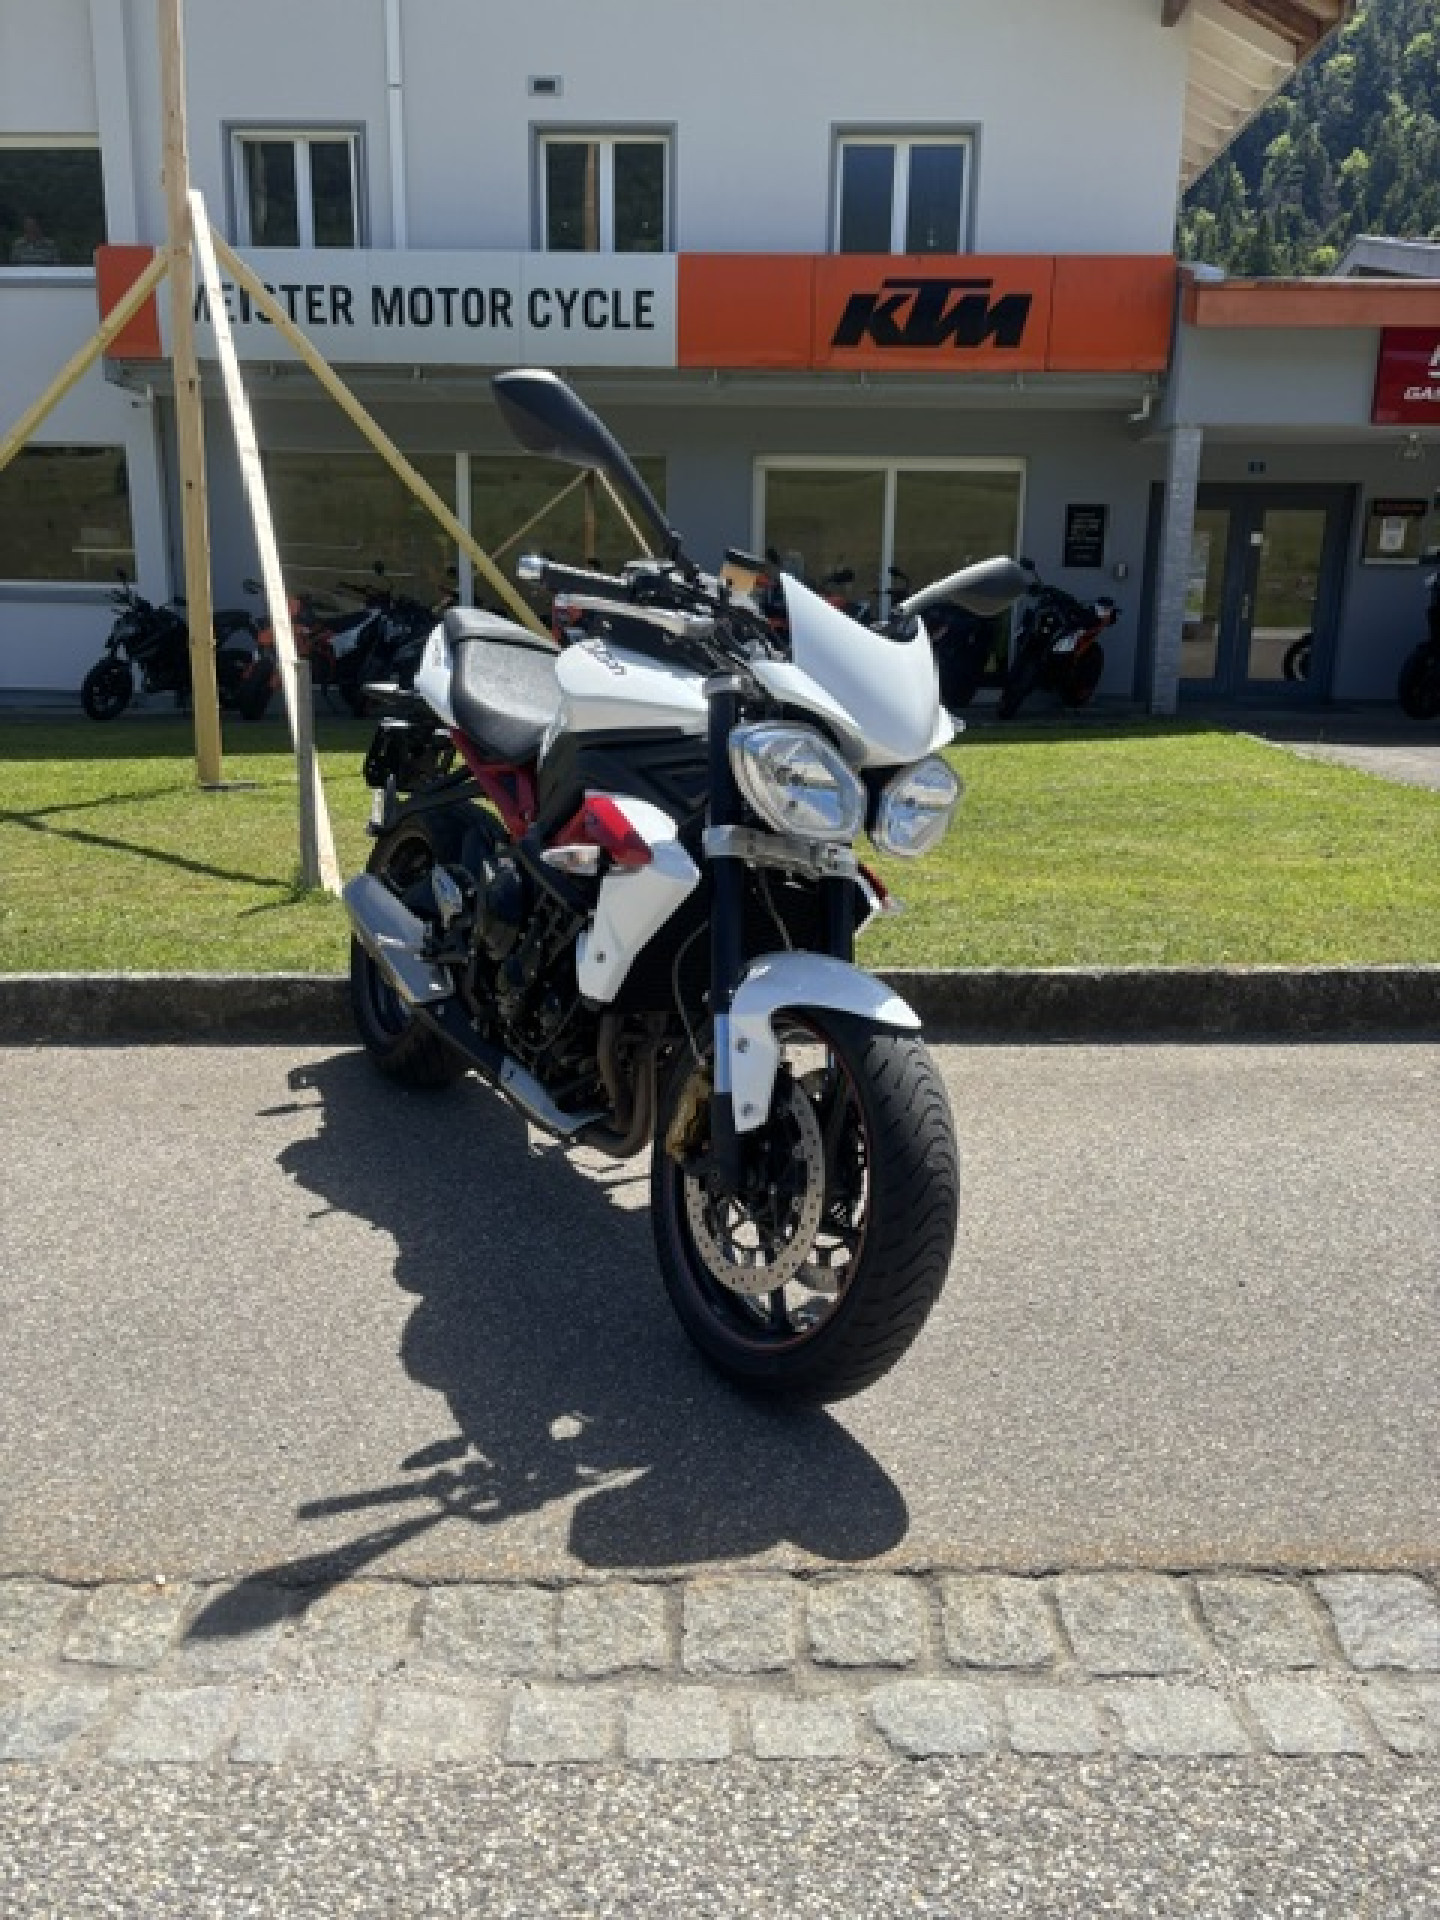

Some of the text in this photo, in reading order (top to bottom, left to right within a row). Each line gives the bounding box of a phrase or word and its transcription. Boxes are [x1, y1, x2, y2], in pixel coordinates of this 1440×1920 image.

[371, 286, 513, 328] MOTOR
[527, 288, 655, 330] CYCLE
[831, 278, 1033, 348] KTM
